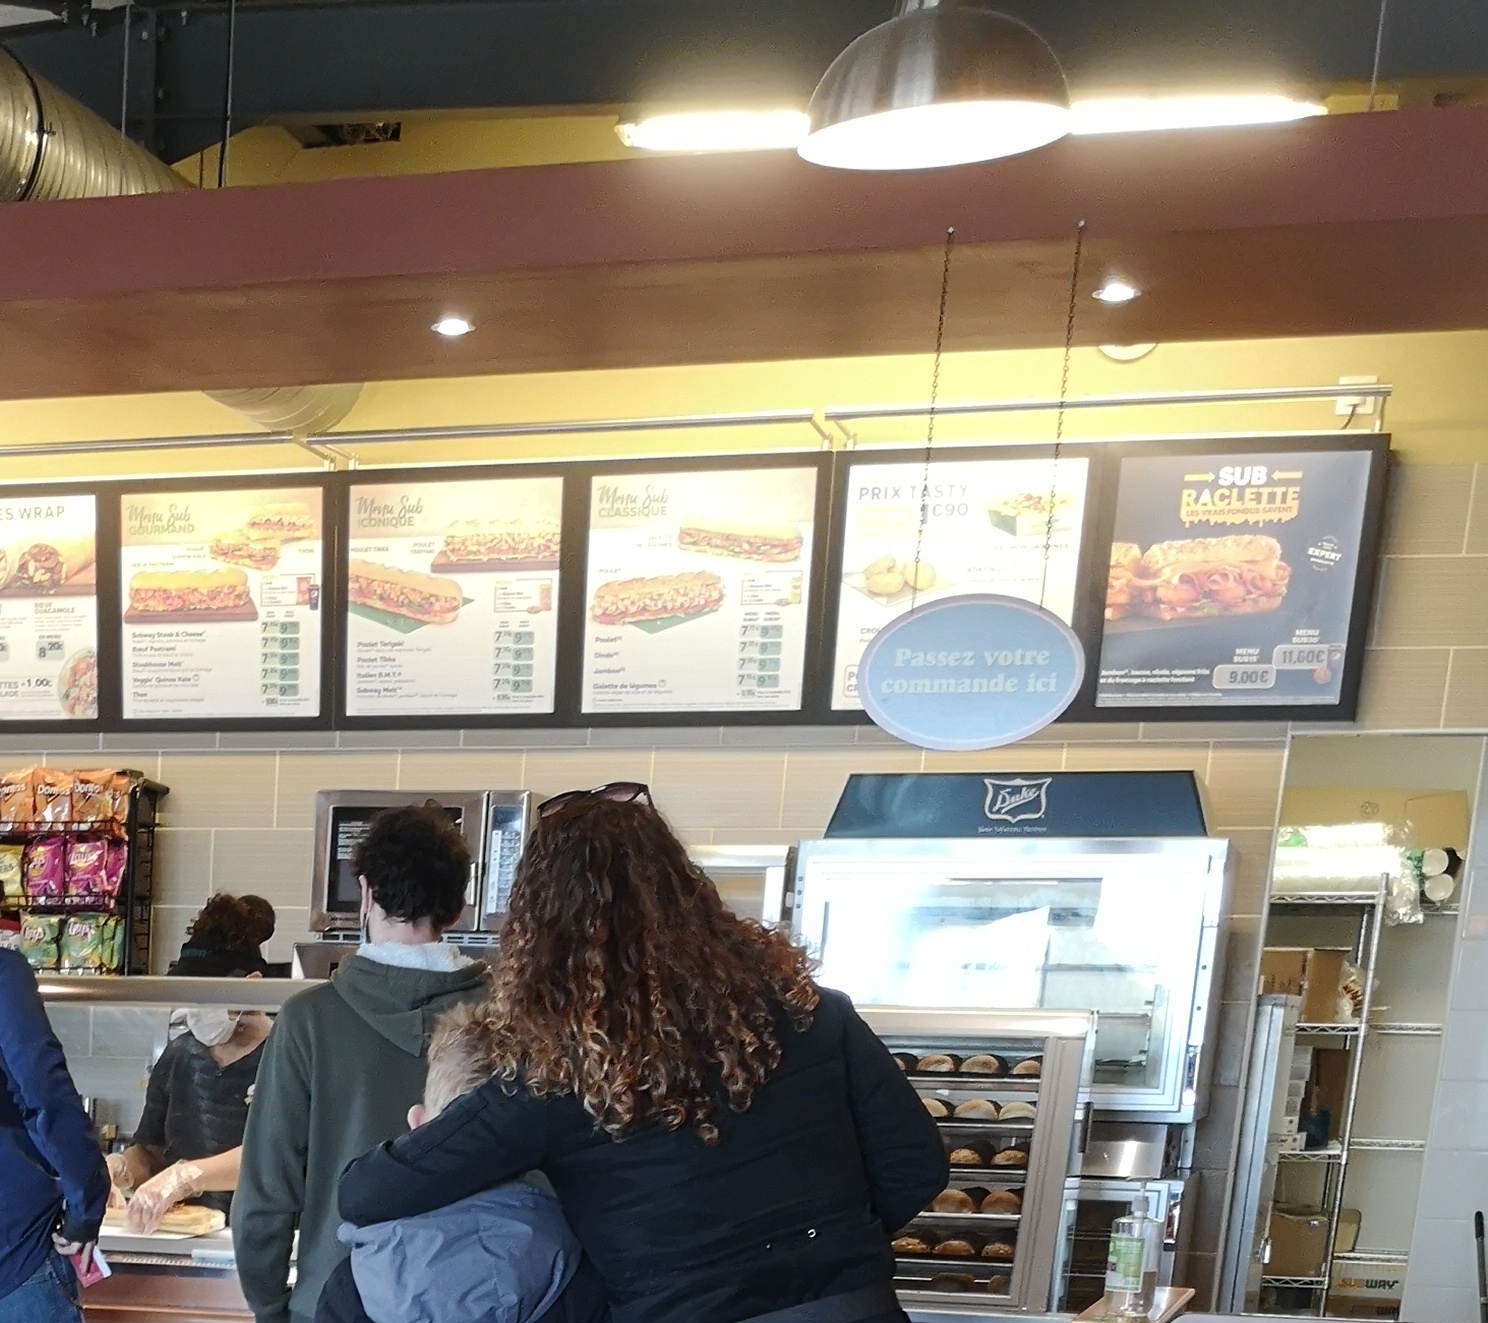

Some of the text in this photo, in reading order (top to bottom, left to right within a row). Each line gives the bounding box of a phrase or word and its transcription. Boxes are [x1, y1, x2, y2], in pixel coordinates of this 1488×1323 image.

[1218, 465, 1267, 486] SUB
[597, 484, 669, 510] Menu Sub
[859, 484, 968, 500] PRIX TASTY
[1181, 486, 1300, 507] RACLETTE
[19, 505, 65, 520] WRAP
[127, 503, 192, 527] Menu Sub
[356, 495, 424, 520] Menu Sub
[598, 506, 668, 519] CLASSIQUE
[1186, 506, 1293, 517] LES VRAIS FONDUS SAVENT
[129, 524, 195, 536] GOURMAND
[357, 516, 415, 529] ICONIQUE
[1307, 547, 1342, 562] EXPERT
[1295, 629, 1320, 637] MENU
[895, 647, 1050, 667] Passez votre
[880, 672, 1018, 694] commande
[1025, 671, 1058, 693] ici
[1335, 1278, 1399, 1291] SUBWAY
